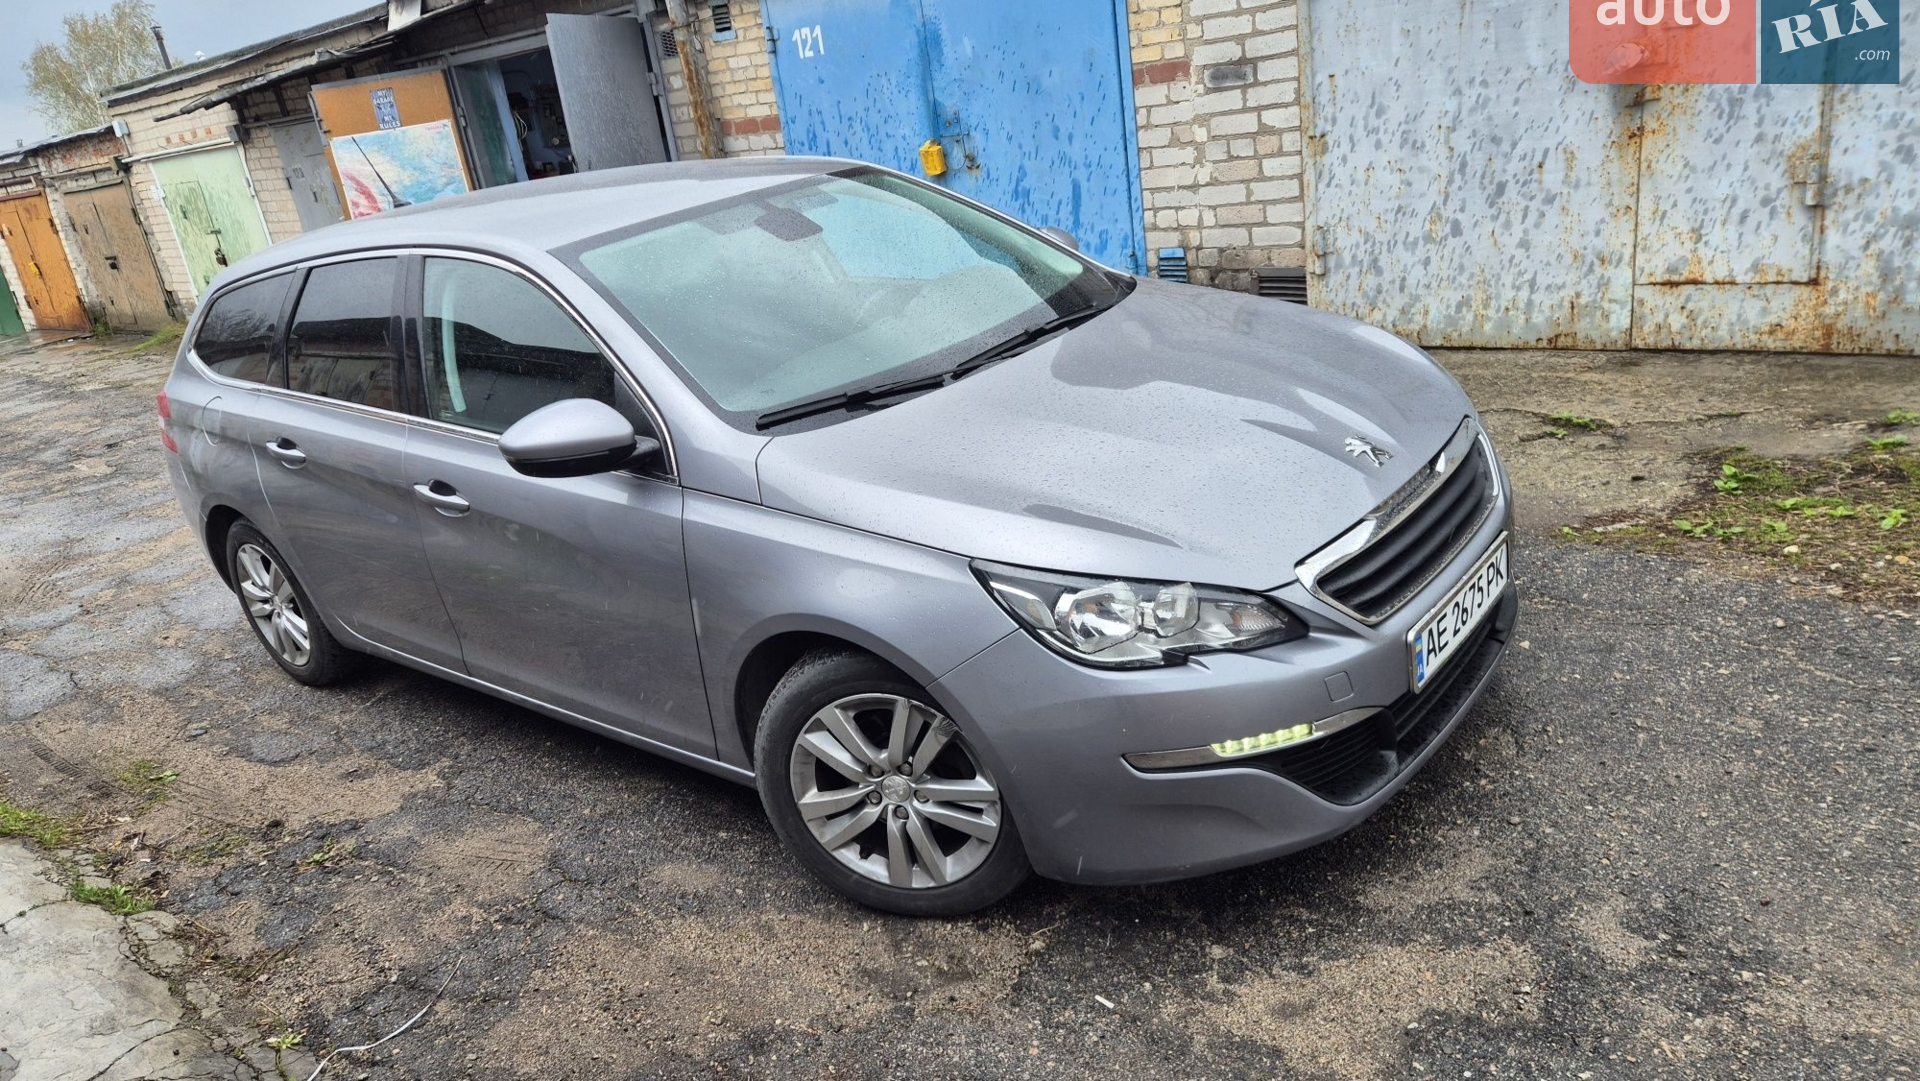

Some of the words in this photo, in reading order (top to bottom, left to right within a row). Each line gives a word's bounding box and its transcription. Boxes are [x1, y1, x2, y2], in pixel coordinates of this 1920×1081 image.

[791, 25, 825, 59] 121
[379, 120, 401, 130] RULES
[1426, 611, 1449, 668] AE
[1452, 573, 1484, 639] 2675
[1486, 548, 1504, 599] PK
